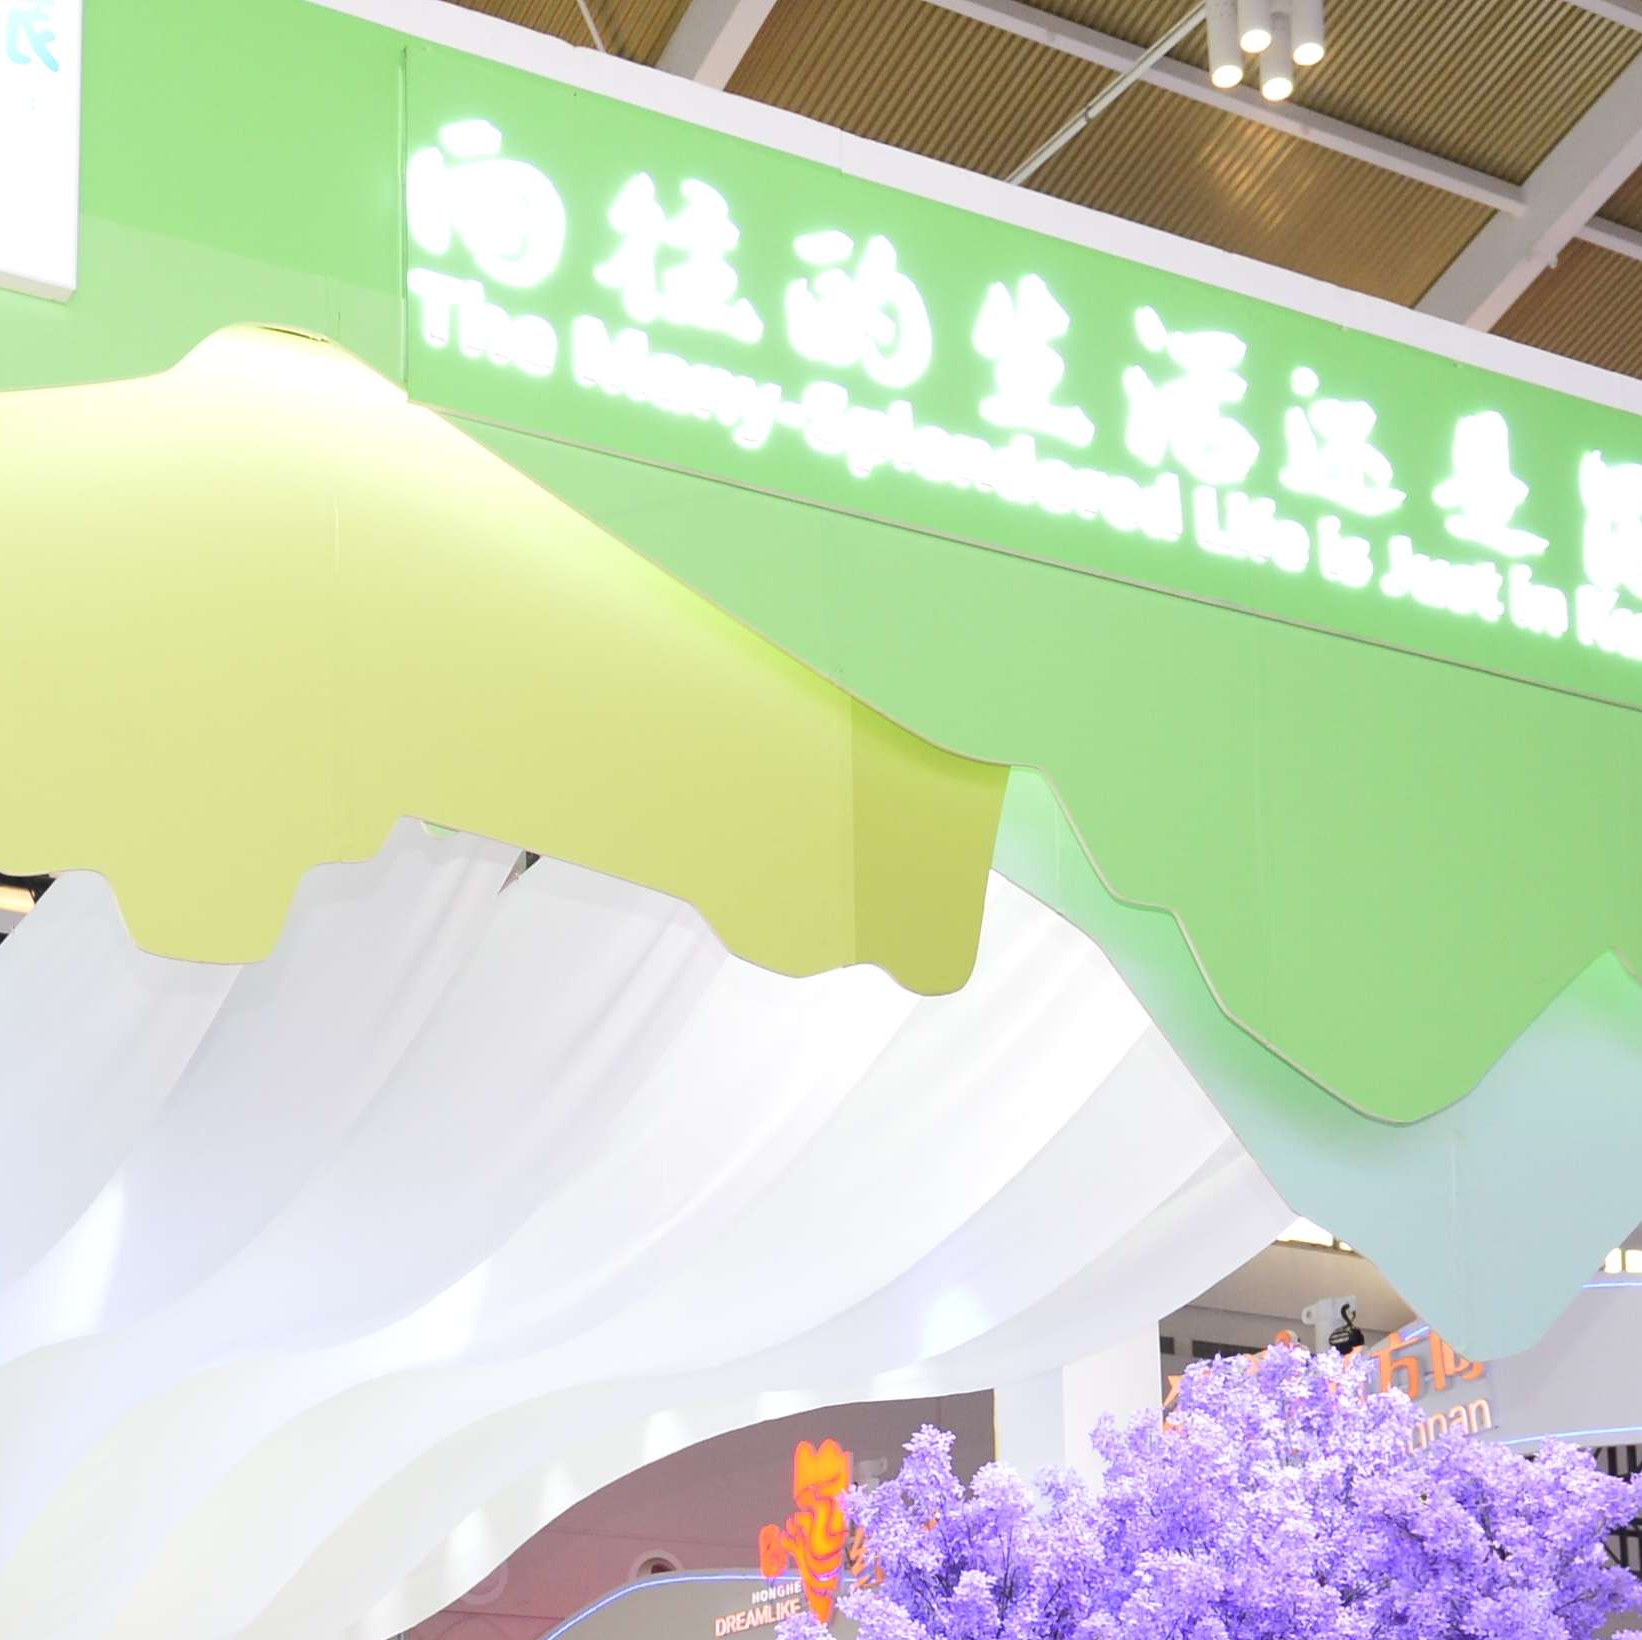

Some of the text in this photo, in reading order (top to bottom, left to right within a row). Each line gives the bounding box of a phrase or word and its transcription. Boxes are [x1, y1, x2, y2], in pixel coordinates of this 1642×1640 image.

[408, 267, 558, 376] The
[1193, 485, 1310, 572] Life
[1379, 535, 1505, 622] Just
[751, 1580, 802, 1605] HONGHE
[715, 1598, 802, 1638] DREAMLIKE
